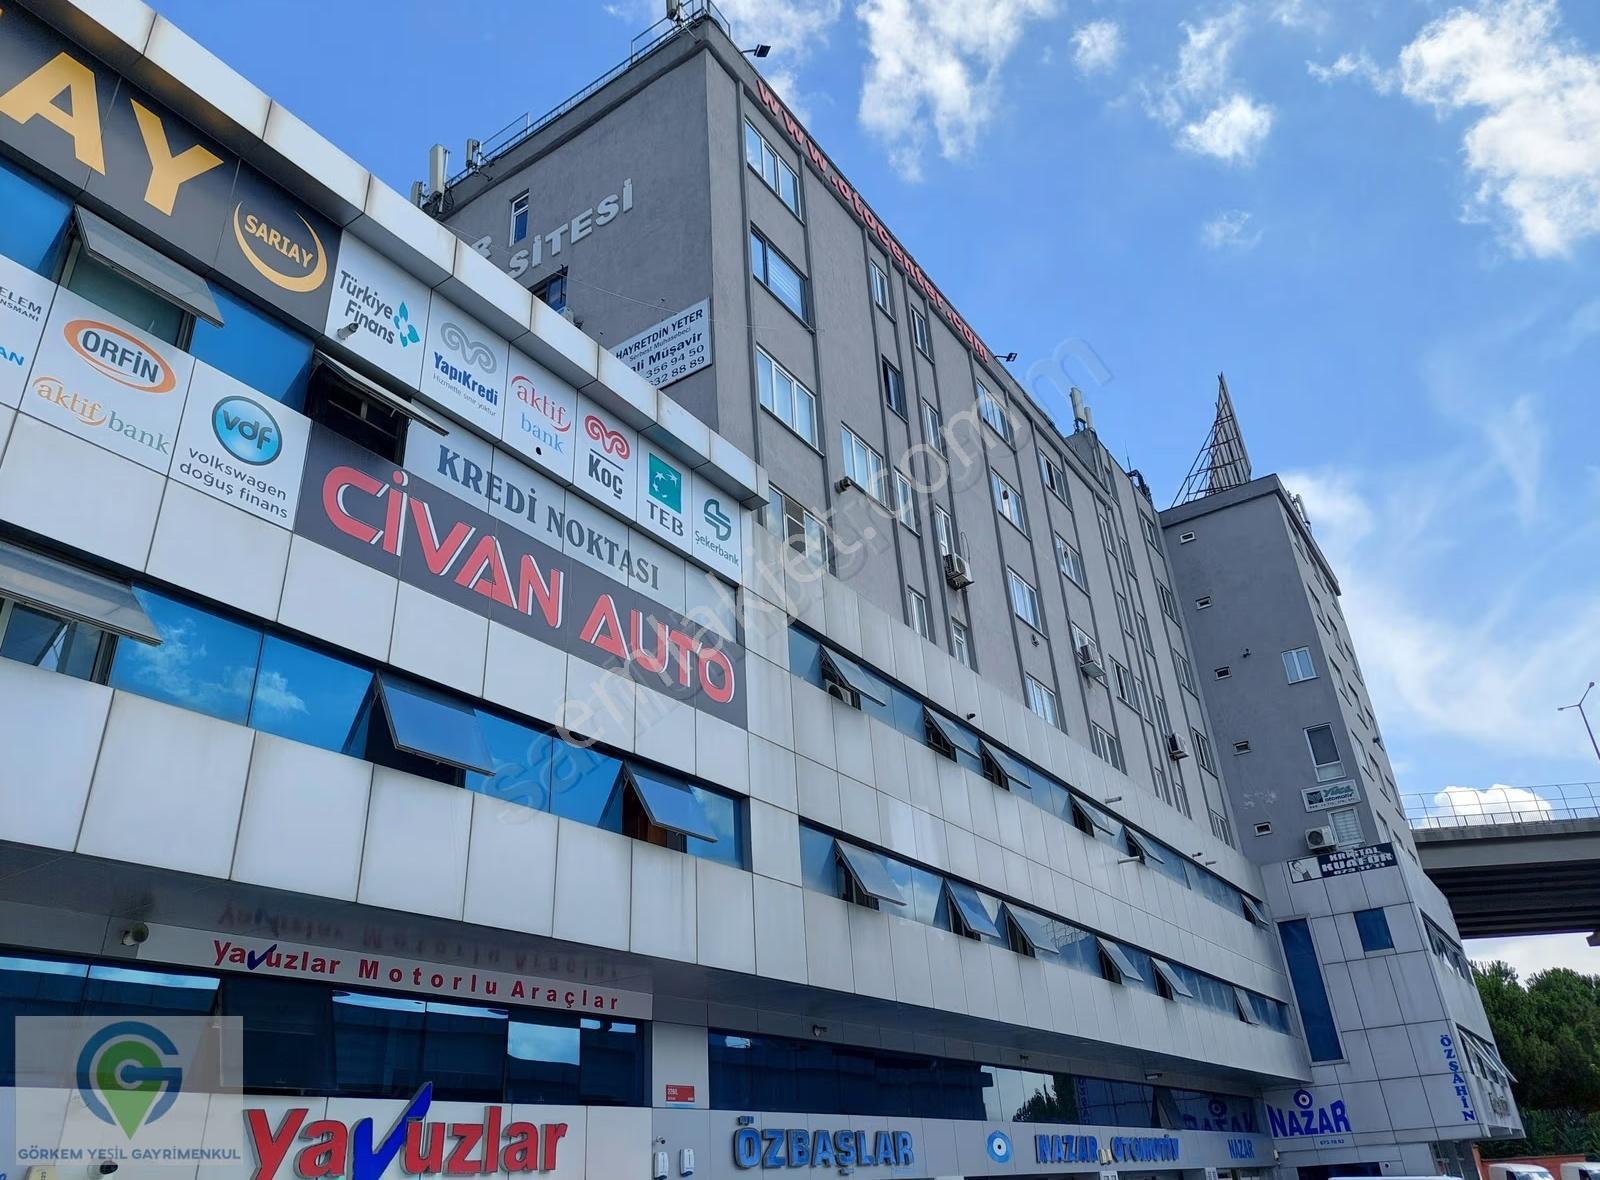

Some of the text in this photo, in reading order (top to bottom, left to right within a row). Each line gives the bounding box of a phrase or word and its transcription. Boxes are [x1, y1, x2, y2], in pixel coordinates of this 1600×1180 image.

[0, 51, 224, 216] AY
[245, 214, 313, 268] SARIAY
[506, 178, 633, 279] SİTESİ
[337, 270, 393, 320] Türkiye
[345, 299, 394, 345] Finans
[671, 309, 703, 332] YETER
[82, 330, 159, 383] ORFİN
[629, 327, 691, 362] Serbest Muhasebeci
[646, 344, 704, 379] 356 94 50
[648, 332, 703, 366] Müşavir
[671, 364, 687, 378] 88
[689, 355, 705, 369] 89
[434, 352, 498, 406] YapıKredi
[36, 381, 171, 455] aktif bank
[517, 384, 567, 425] aktif
[222, 410, 273, 450] vdf
[521, 412, 565, 454] bank
[180, 462, 288, 519] doğuş finans
[188, 447, 287, 501] volkswagen
[437, 444, 660, 590] KREDİ NOKTASI
[646, 500, 684, 537] TEB
[695, 530, 740, 567] Şekerbank
[322, 465, 735, 703] CİVAN AUTO
[358, 958, 497, 995] Motorlu
[511, 980, 618, 1009] Araçlar
[1266, 1100, 1352, 1137] NAZAR
[734, 1116, 914, 1176] ÖZBAŞLAR
[1035, 1134, 1098, 1164] NAZAR
[1227, 1138, 1255, 1160] NAZAR
